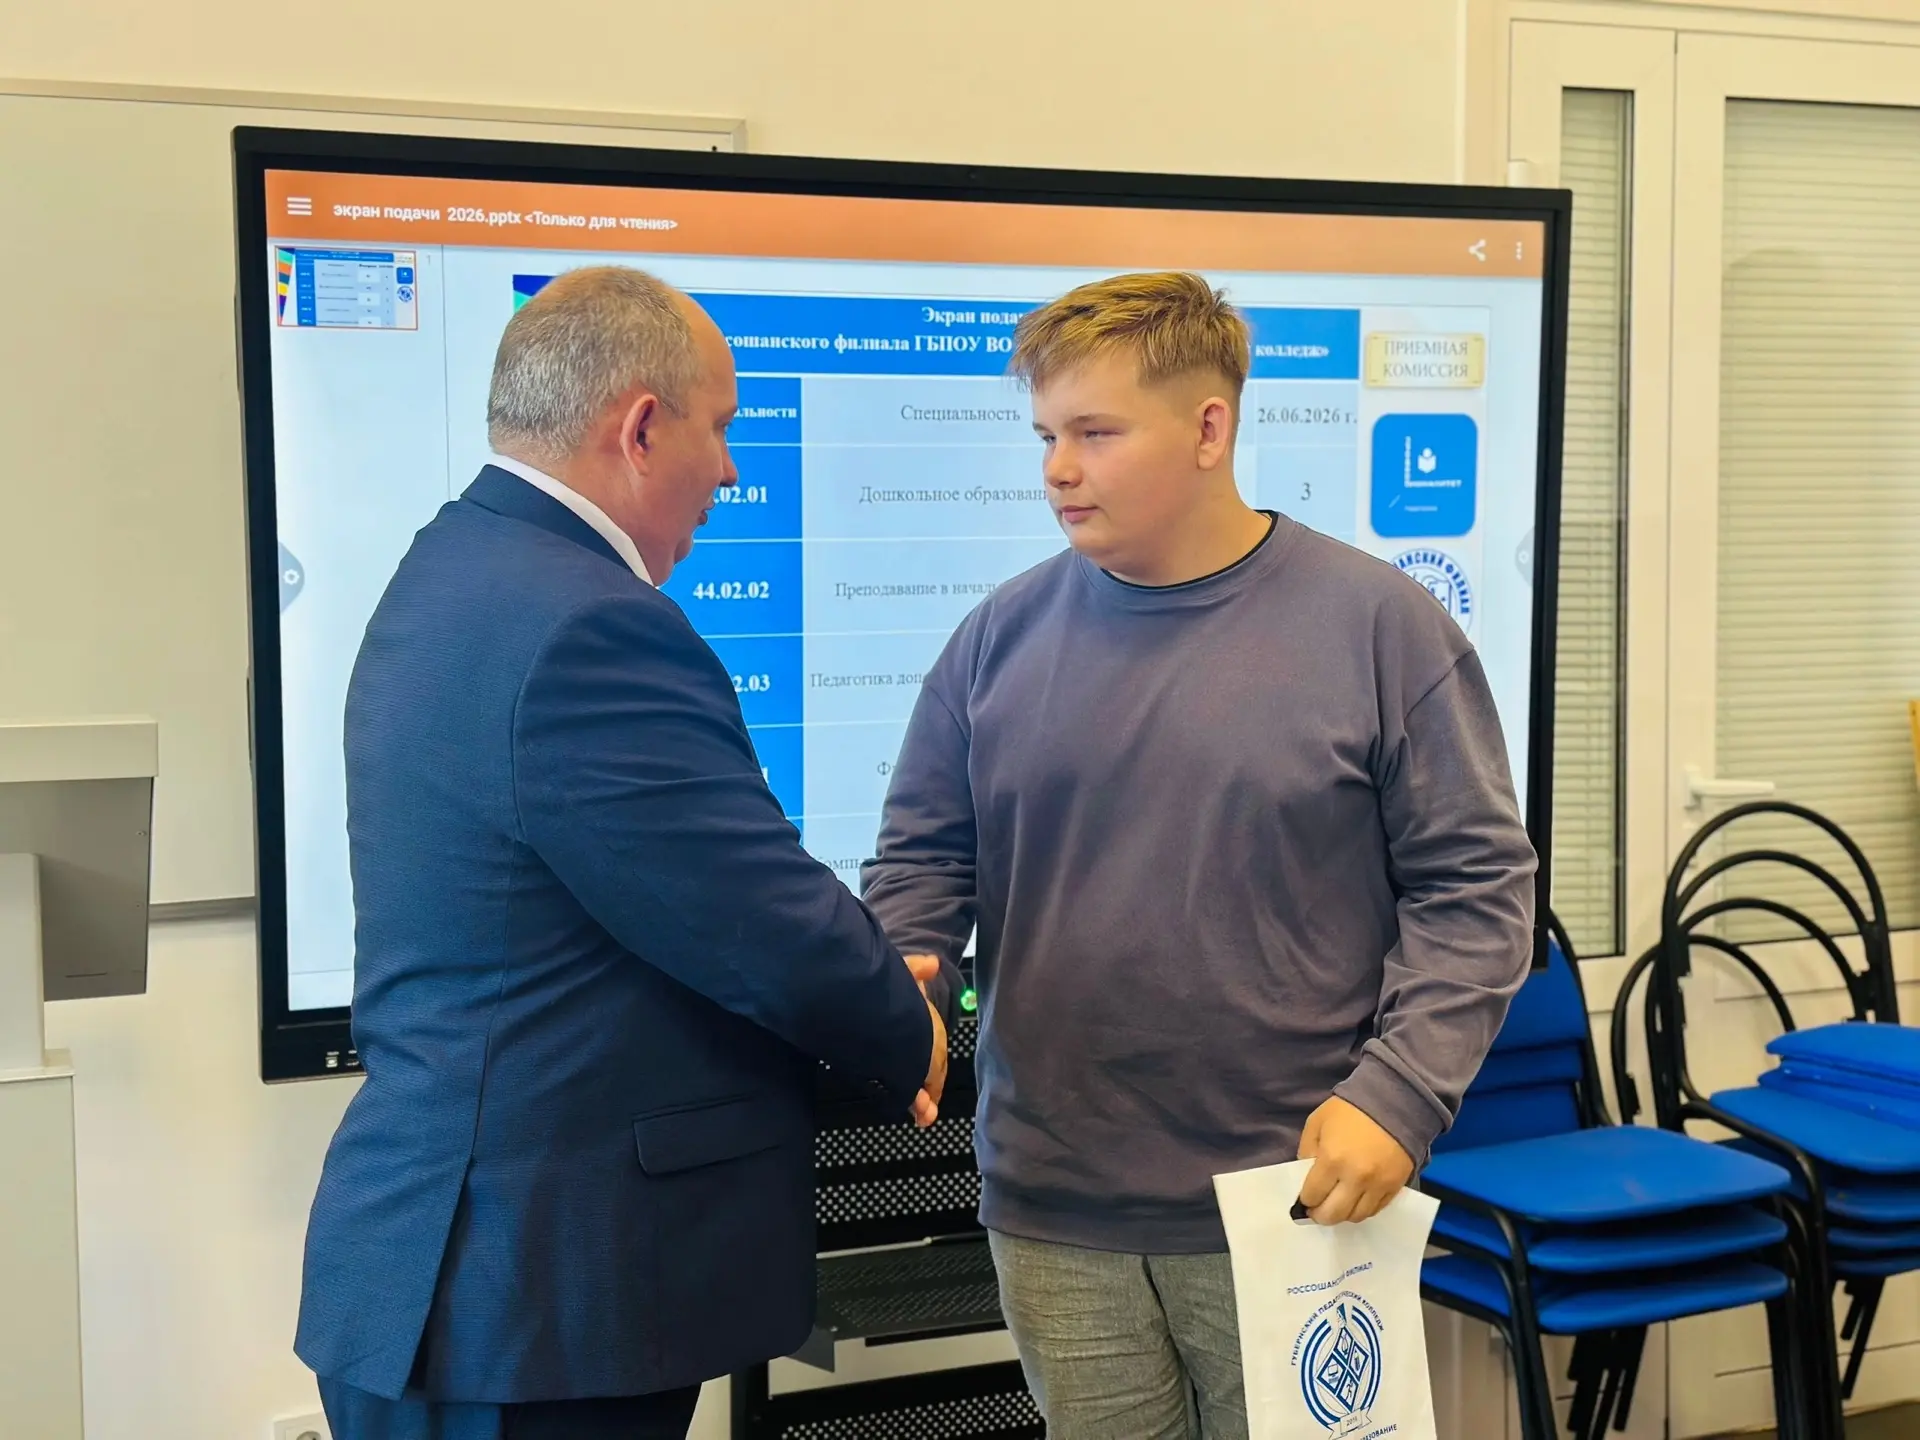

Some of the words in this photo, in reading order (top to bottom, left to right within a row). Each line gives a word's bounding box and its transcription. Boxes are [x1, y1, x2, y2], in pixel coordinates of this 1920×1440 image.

[333, 204, 380, 220] экран
[384, 207, 440, 222] подачи
[447, 207, 521, 226] 2026.pptx
[524, 210, 586, 227] <Только
[588, 216, 617, 230] для
[619, 217, 679, 230] чтения>
[921, 306, 976, 327] Экран
[834, 333, 910, 354] филиала
[915, 334, 981, 353] ГБПОУ
[986, 337, 1012, 353] ВО
[1384, 340, 1468, 357] ПРИЕМНАЯ
[1383, 364, 1468, 379] КОМИССИЯ
[900, 405, 1021, 421] Специальность
[1257, 408, 1341, 424] 26.06.2026
[1345, 411, 1358, 424] г.
[859, 486, 960, 504] Дошкольное
[1300, 482, 1311, 500] 3
[1394, 551, 1445, 569] АНСКИЙ
[693, 580, 769, 600] 44.02.02
[835, 582, 937, 600] Преподавание
[941, 585, 949, 595] в
[810, 673, 893, 692] Педагогика
[896, 673, 924, 687] доп
